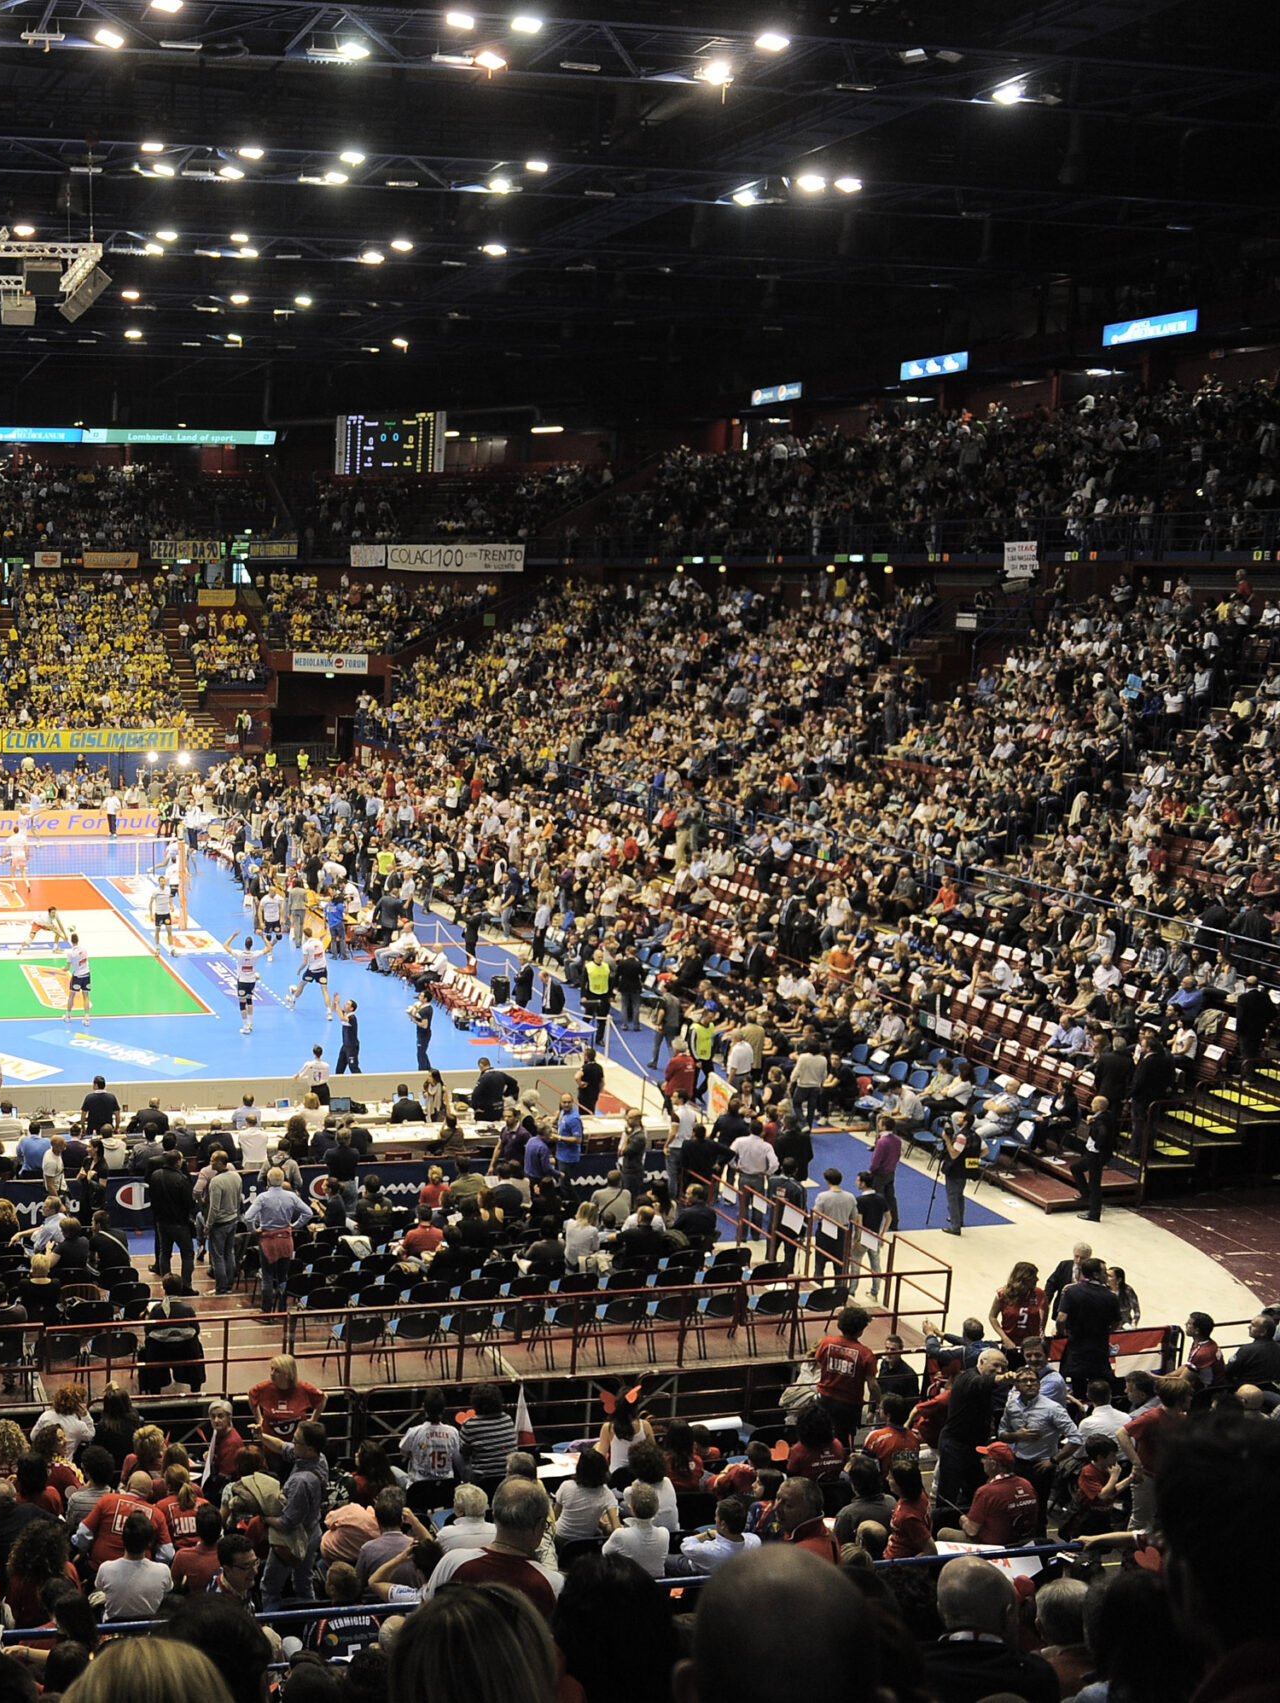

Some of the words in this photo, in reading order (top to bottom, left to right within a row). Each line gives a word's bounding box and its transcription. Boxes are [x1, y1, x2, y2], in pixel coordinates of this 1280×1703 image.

[127, 432, 174, 441] Lombardia.
[177, 433, 197, 442] Land
[198, 433, 209, 442] of
[211, 434, 237, 444] sport.
[152, 541, 177, 557] PEZZI
[192, 541, 205, 556] DA
[207, 541, 218, 557] 90
[478, 548, 523, 562] TRENTO
[294, 657, 333, 668] MEDIOLANUM
[344, 659, 366, 669] FORUM
[6, 731, 62, 749] CURVA
[69, 731, 175, 750] GISLIMBERTI
[829, 1356, 855, 1376] LUBE
[429, 1450, 447, 1470] 15
[175, 1516, 197, 1534] LUB
